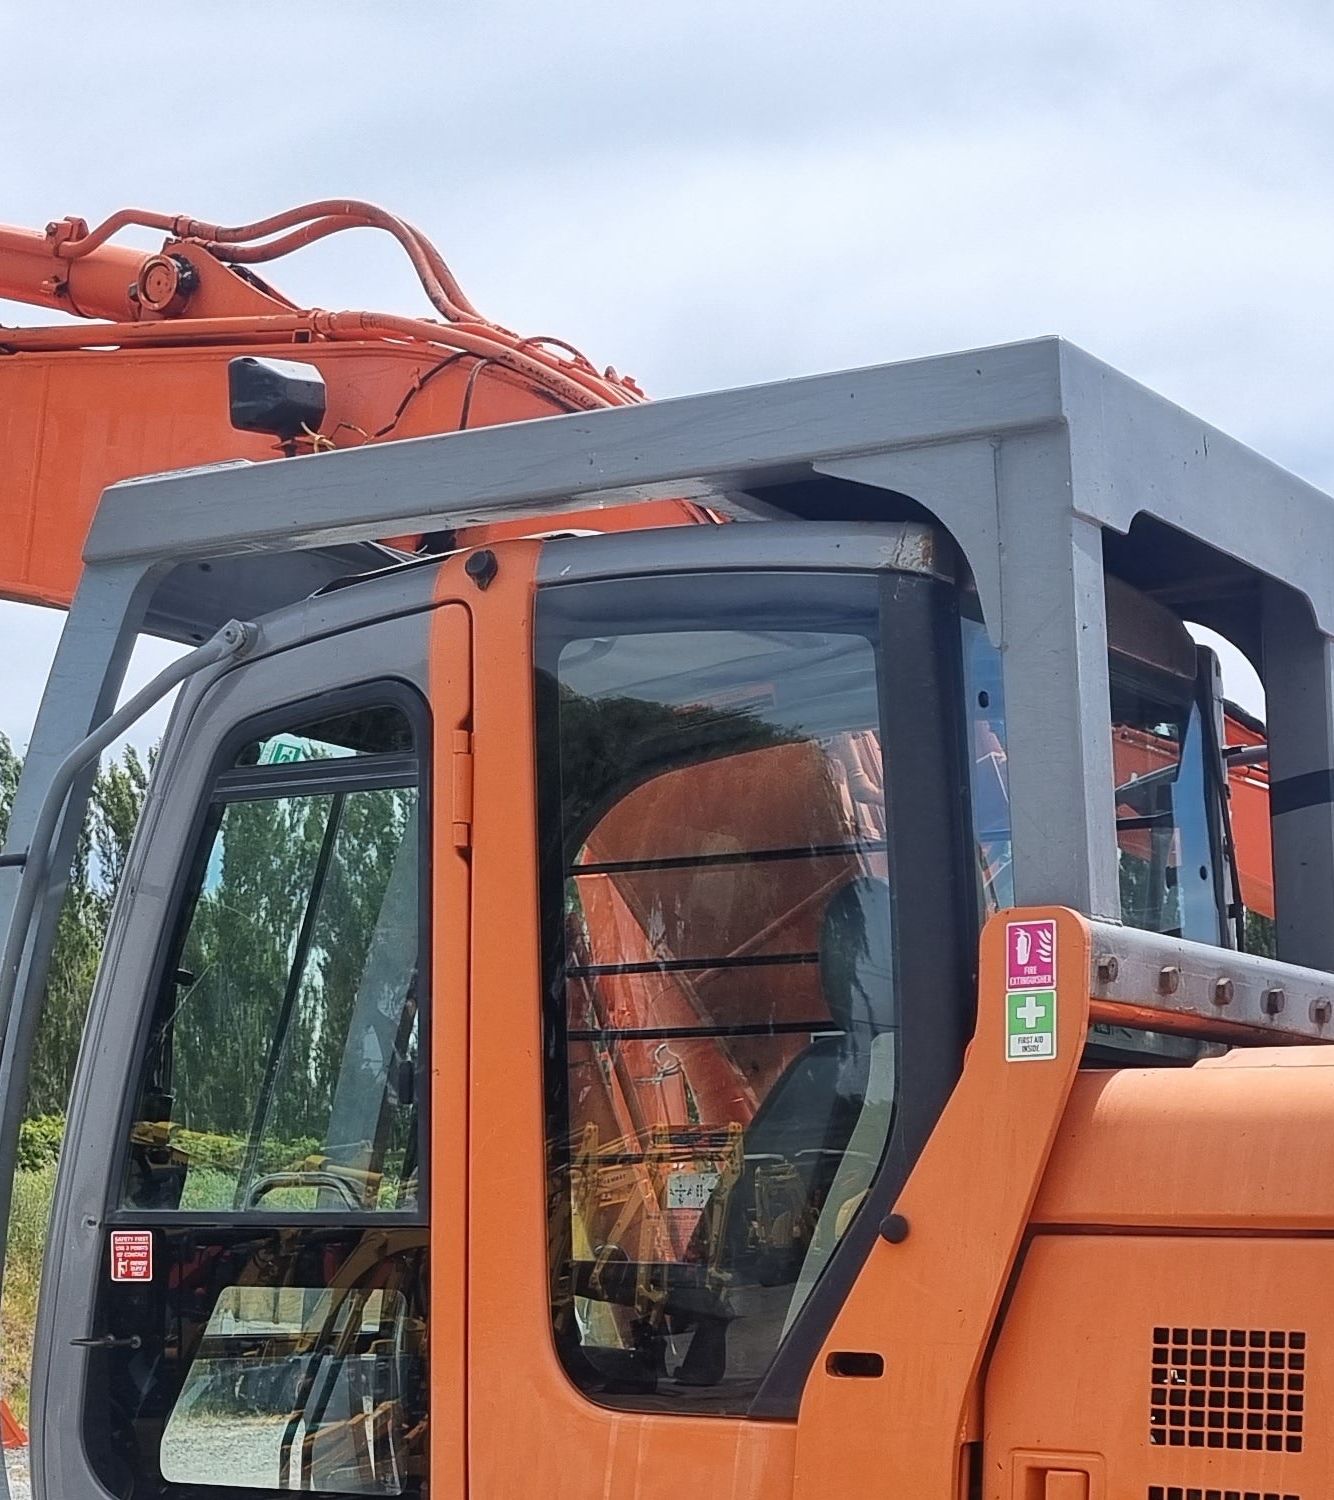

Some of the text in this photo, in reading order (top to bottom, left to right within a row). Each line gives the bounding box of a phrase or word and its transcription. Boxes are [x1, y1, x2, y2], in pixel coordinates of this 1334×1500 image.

[1024, 966, 1037, 975] FIRE
[1018, 1036, 1044, 1044] FIRST AID
[1021, 1044, 1040, 1053] INSIDE
